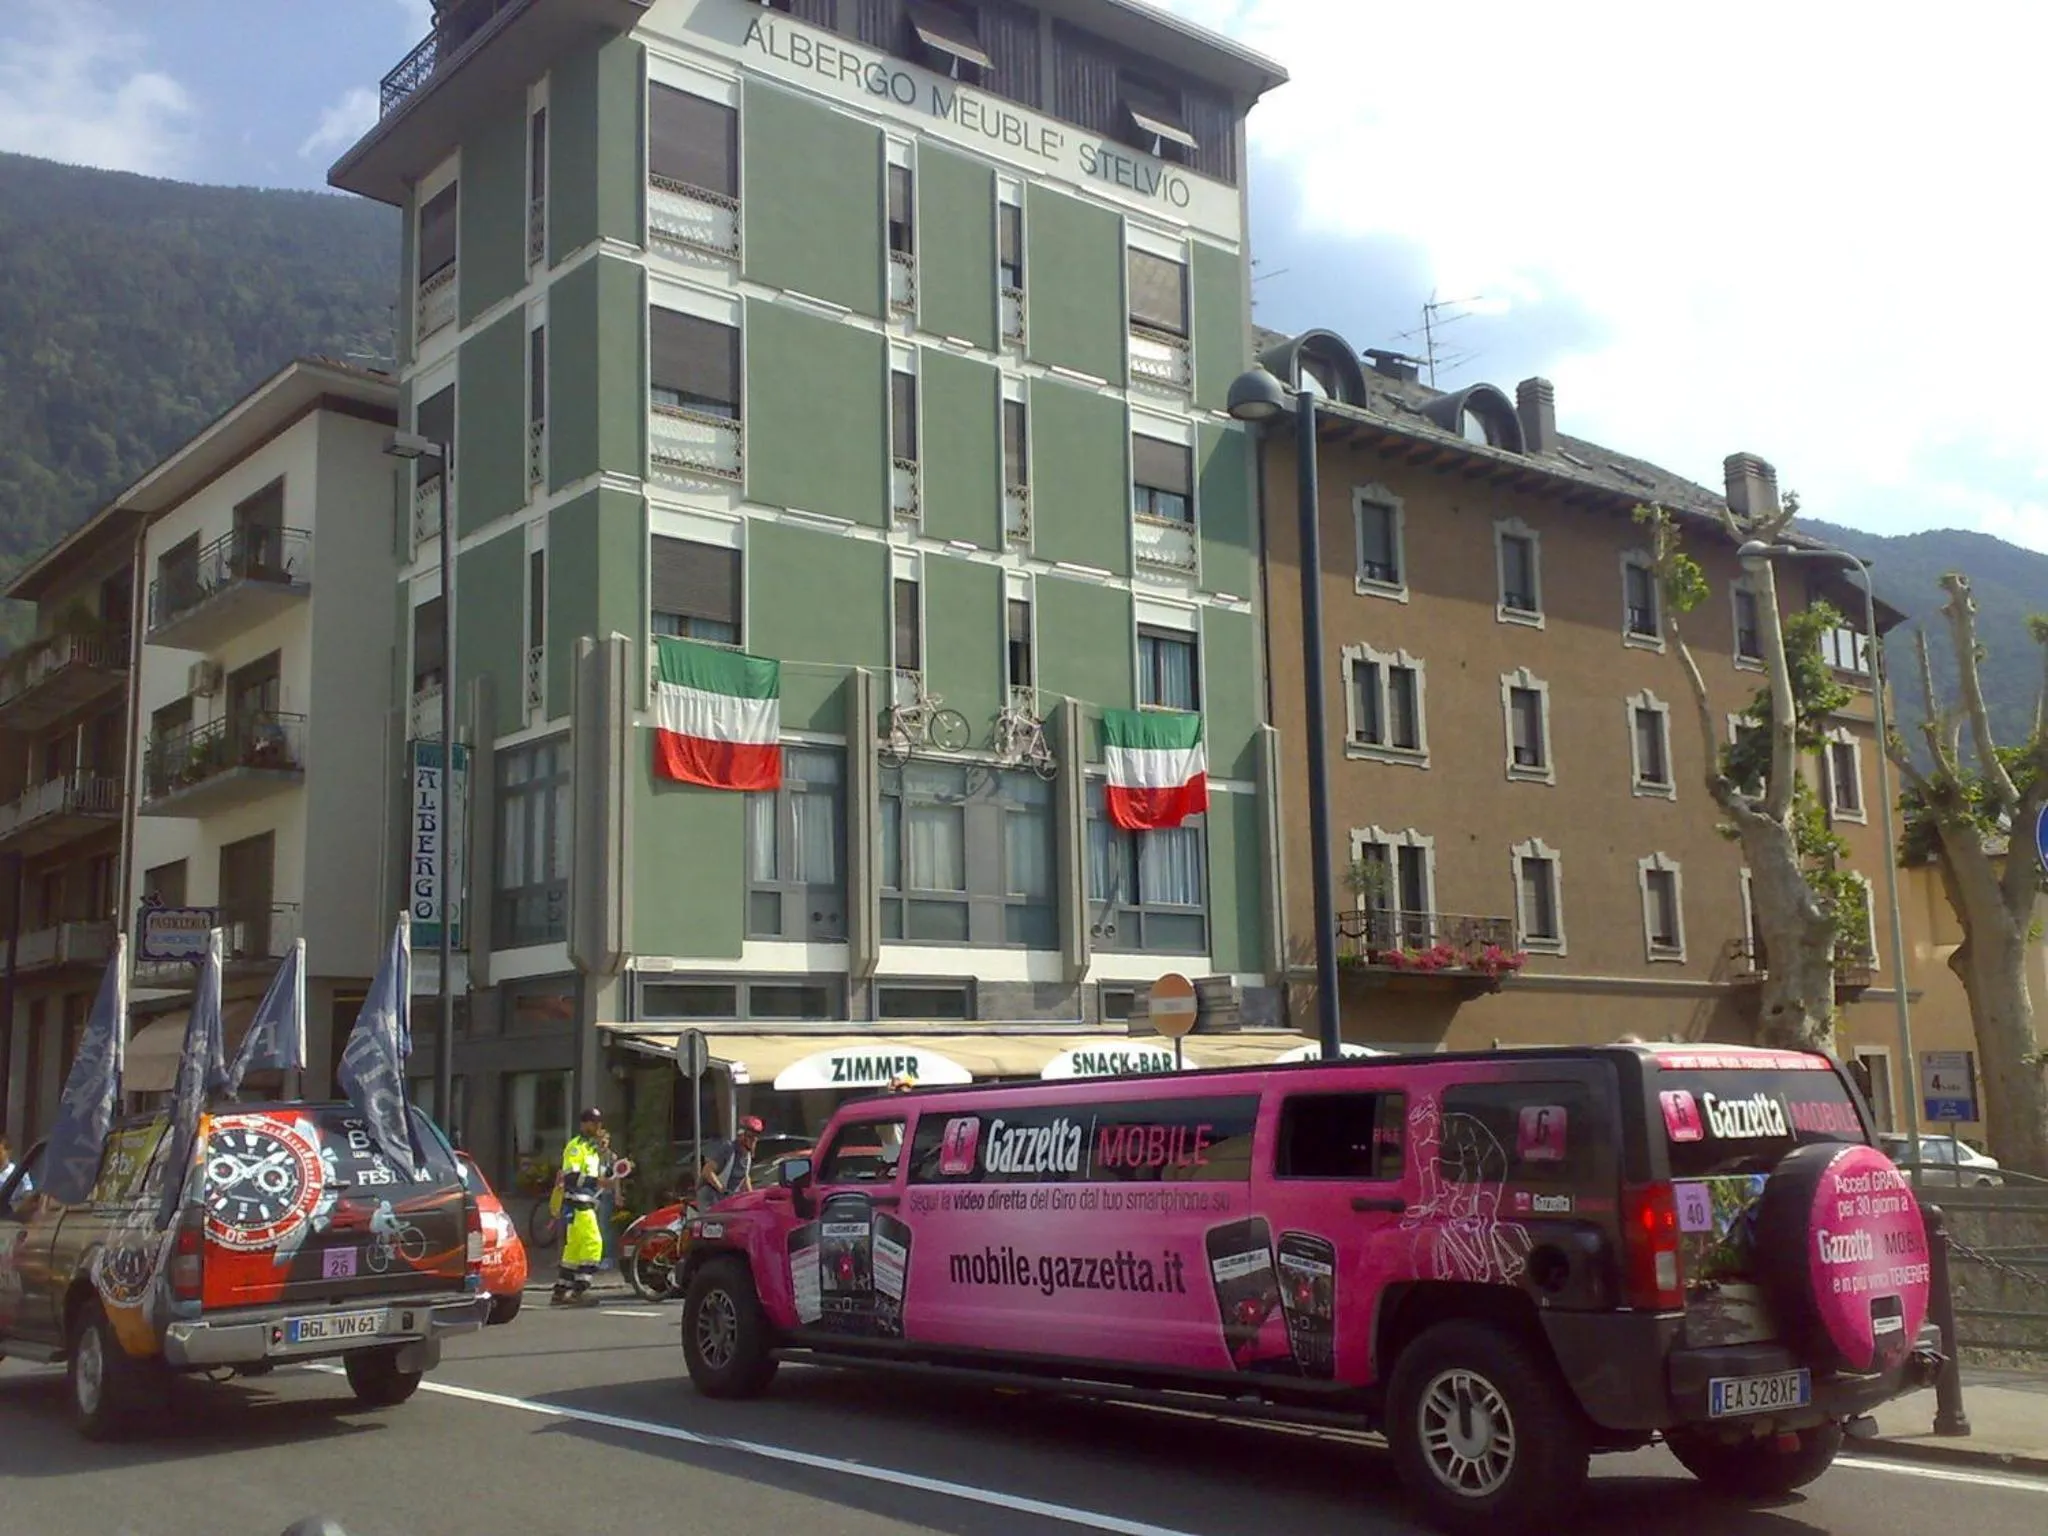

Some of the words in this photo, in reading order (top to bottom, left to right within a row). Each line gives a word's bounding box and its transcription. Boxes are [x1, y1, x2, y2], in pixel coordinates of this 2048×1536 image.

[743, 17, 917, 106] ALBERGO
[1078, 143, 1191, 208] STELVIO
[414, 769, 437, 920] ALBERGO
[831, 1056, 919, 1082] ZIMMER
[1072, 1052, 1173, 1074] SNACK-BAR
[1703, 1091, 1787, 1138] Gazzetta
[1792, 1101, 1862, 1133] MOBILE
[985, 1118, 1081, 1173] Gazzetta
[1097, 1123, 1213, 1168] MOBILE
[954, 1189, 984, 1210] video
[988, 1188, 1026, 1210] diretta
[1030, 1188, 1048, 1209] del
[1052, 1188, 1076, 1210] Giro
[1079, 1188, 1099, 1210] dal
[1103, 1190, 1122, 1210] tuo
[1126, 1188, 1209, 1215] smartphone
[1687, 1203, 1704, 1224] 40
[1838, 1200, 1854, 1221] per
[1857, 1195, 1869, 1215] 30
[1818, 1229, 1873, 1264] Gazzetta
[950, 1246, 1186, 1295] mobile.gazzetta.it
[300, 1321, 328, 1338] BGL
[338, 1317, 355, 1335] VN
[358, 1316, 375, 1332] 61
[1725, 1383, 1744, 1410] EA
[1749, 1376, 1797, 1406] 528XF
